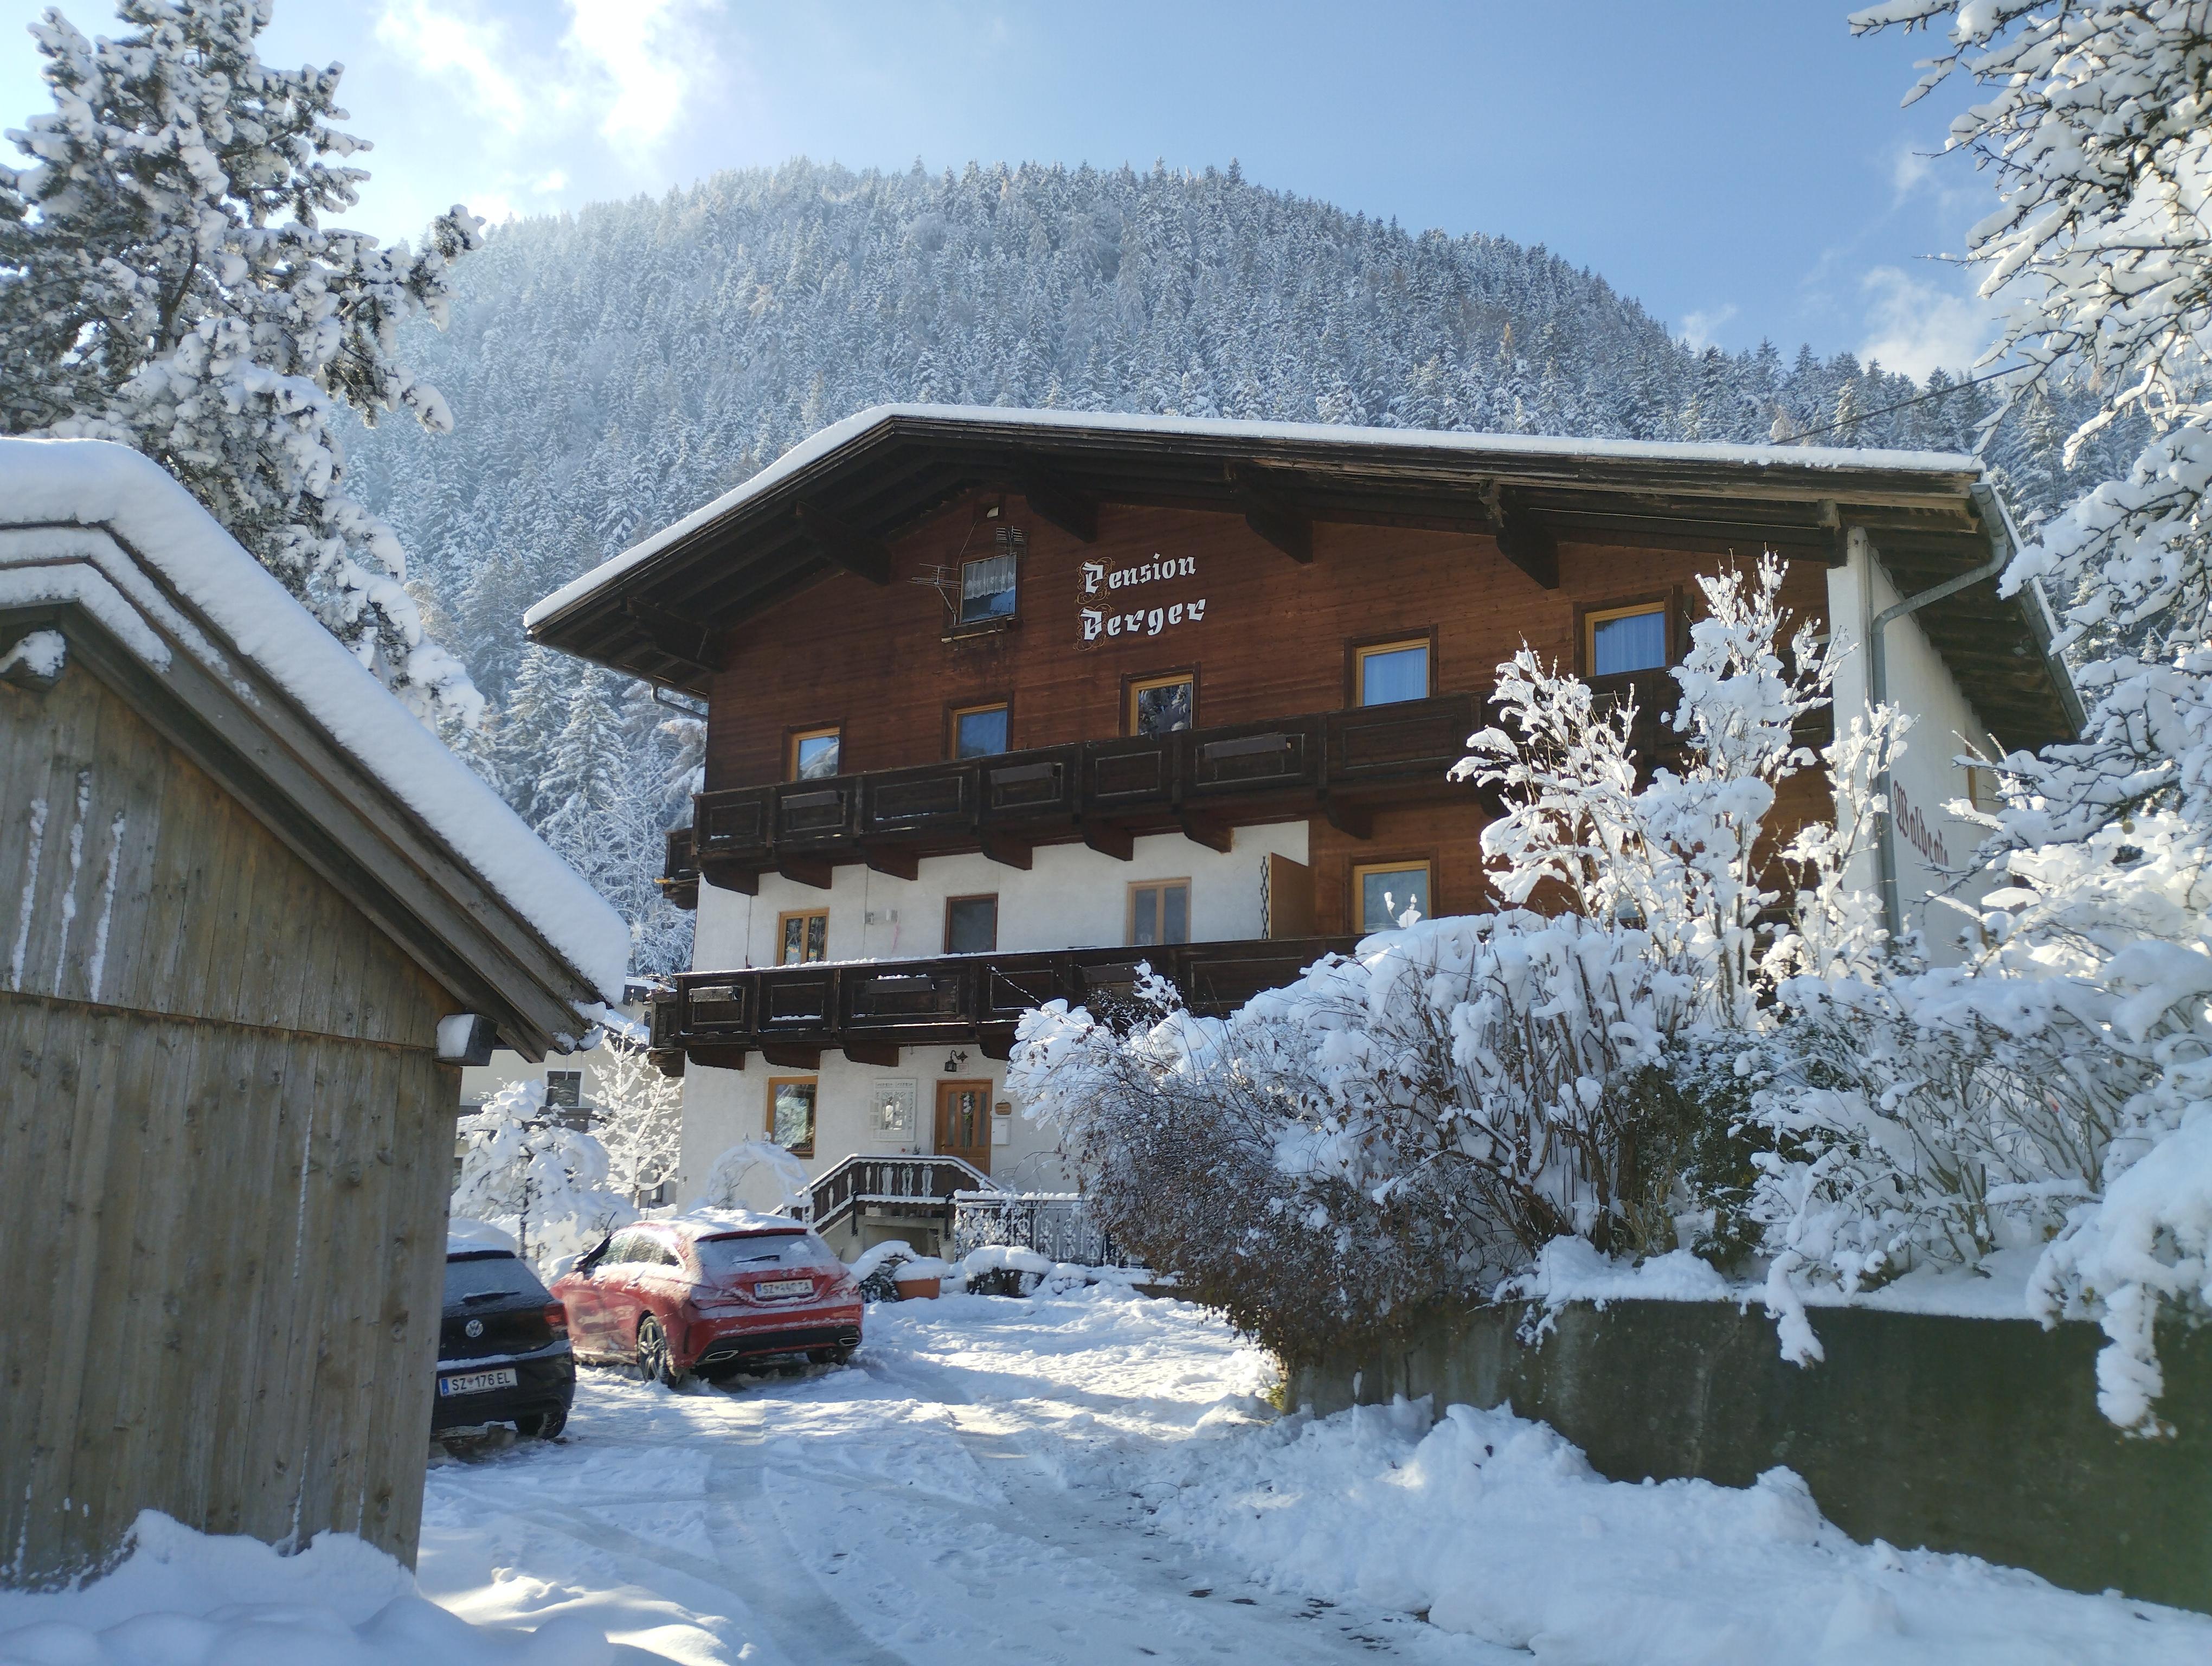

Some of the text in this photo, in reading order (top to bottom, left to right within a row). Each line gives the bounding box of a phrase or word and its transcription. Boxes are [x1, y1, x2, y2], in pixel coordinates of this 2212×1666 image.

[1082, 552, 1196, 594] Pension
[1080, 599, 1206, 640] Berger
[452, 1372, 511, 1391] SZ 176 EL
